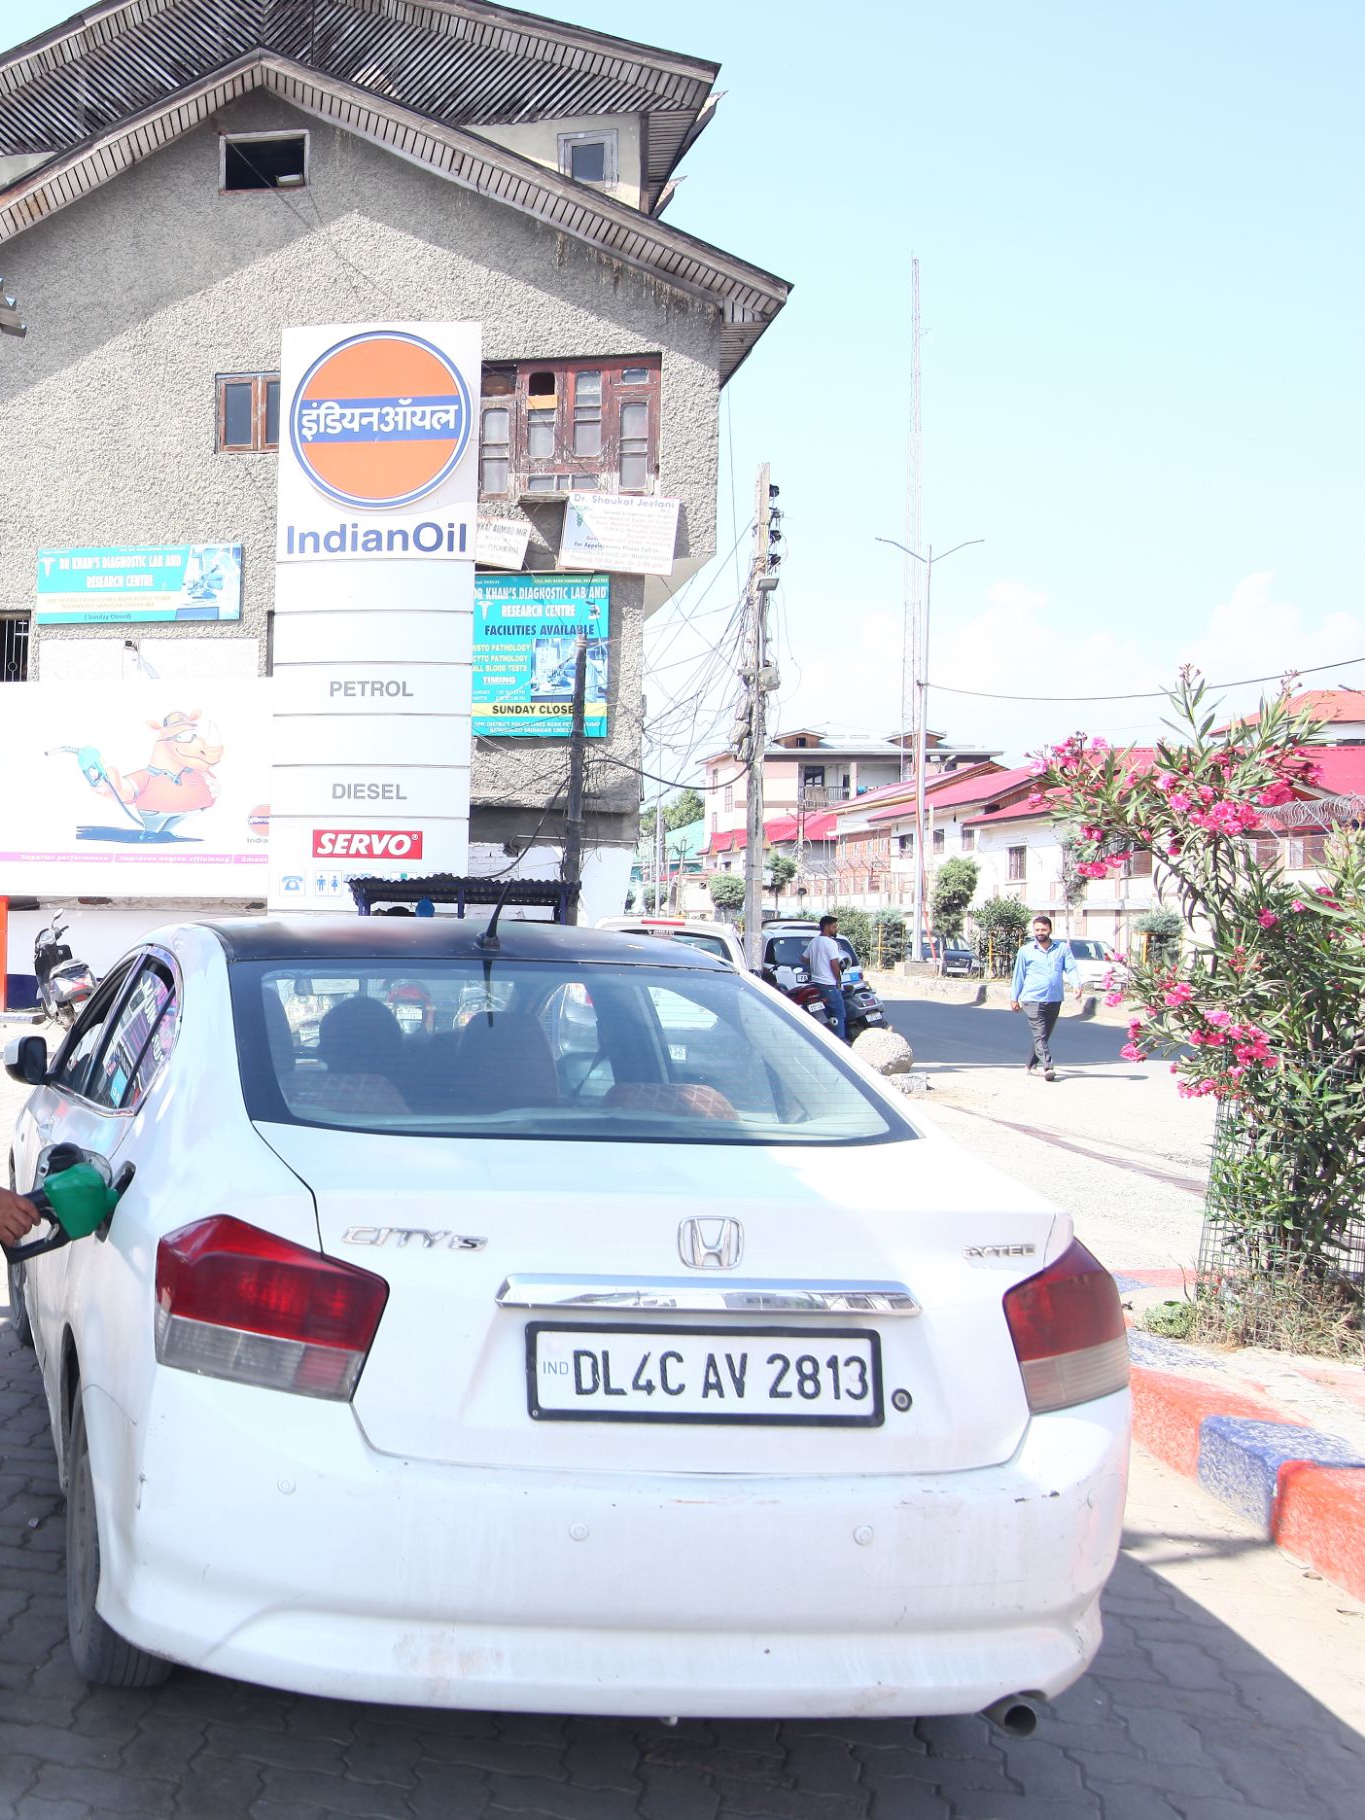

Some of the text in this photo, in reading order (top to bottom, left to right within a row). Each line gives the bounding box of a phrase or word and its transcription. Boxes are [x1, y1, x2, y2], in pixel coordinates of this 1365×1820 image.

[301, 398, 458, 441] इंडियनऑयल
[592, 495, 633, 506] Shaukat
[287, 522, 466, 554] IndianOil
[72, 556, 100, 569] KHAN'S
[102, 555, 146, 569] DIAGNOSTIC
[149, 555, 164, 568] LAB
[165, 554, 182, 567] AND
[86, 574, 154, 588] RESEARCH CENTRE
[486, 587, 517, 600] KHAN'S
[519, 587, 568, 600] DIAGNOSTIC
[571, 587, 587, 600] LAB
[589, 586, 607, 599] AND
[501, 604, 576, 617] RESEARCH CENTRE
[484, 624, 595, 636] FACILITIES AVAILABLE
[473, 644, 530, 652] ISTO PATHOLOGY
[485, 664, 507, 672] BLOOD
[508, 664, 527, 672] TESTS
[483, 676, 515, 685] TIMING
[329, 680, 414, 697] PETROL
[492, 704, 574, 714] SUNDAY CLOSE
[331, 783, 407, 800] DIESEL
[341, 1226, 452, 1248] CITY
[543, 1350, 869, 1401] IND DL4C AV 2813
